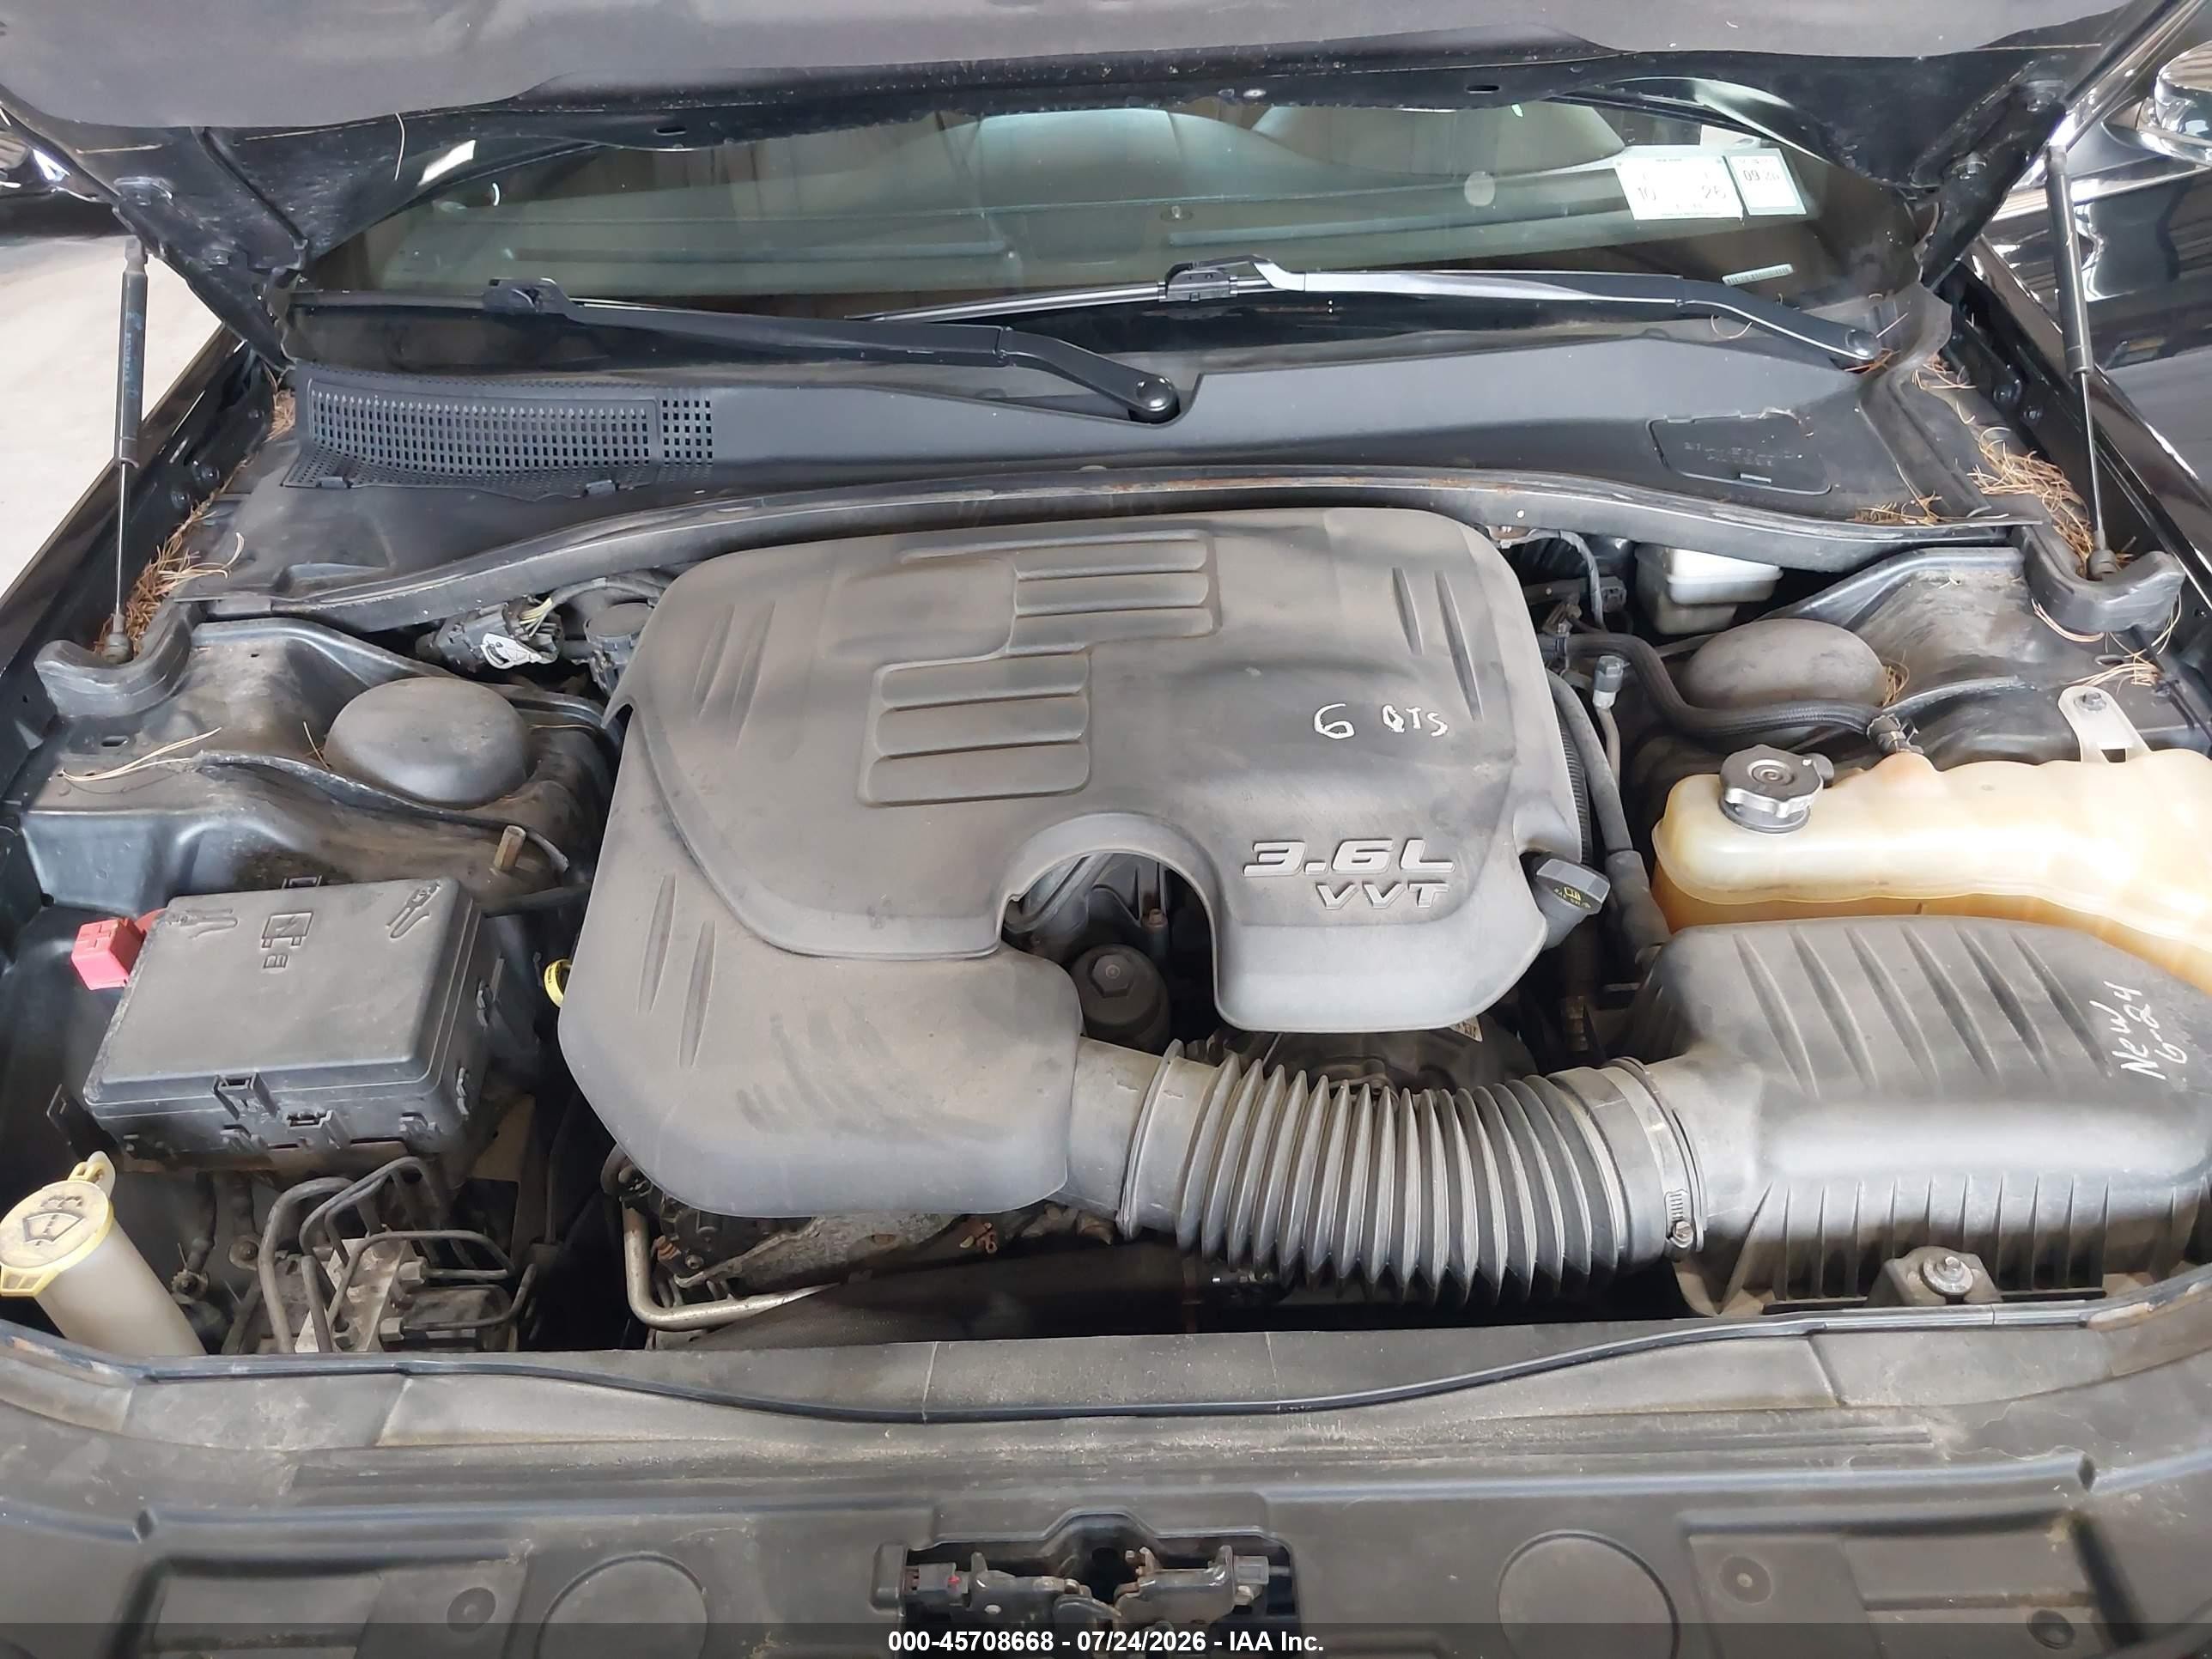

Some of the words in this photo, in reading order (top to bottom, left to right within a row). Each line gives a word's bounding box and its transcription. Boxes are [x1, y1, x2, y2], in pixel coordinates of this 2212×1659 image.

[1314, 702, 1355, 739] 6
[1382, 704, 1449, 737] QTS
[1243, 839, 1455, 877] 3.6L
[1316, 880, 1449, 909] VVT
